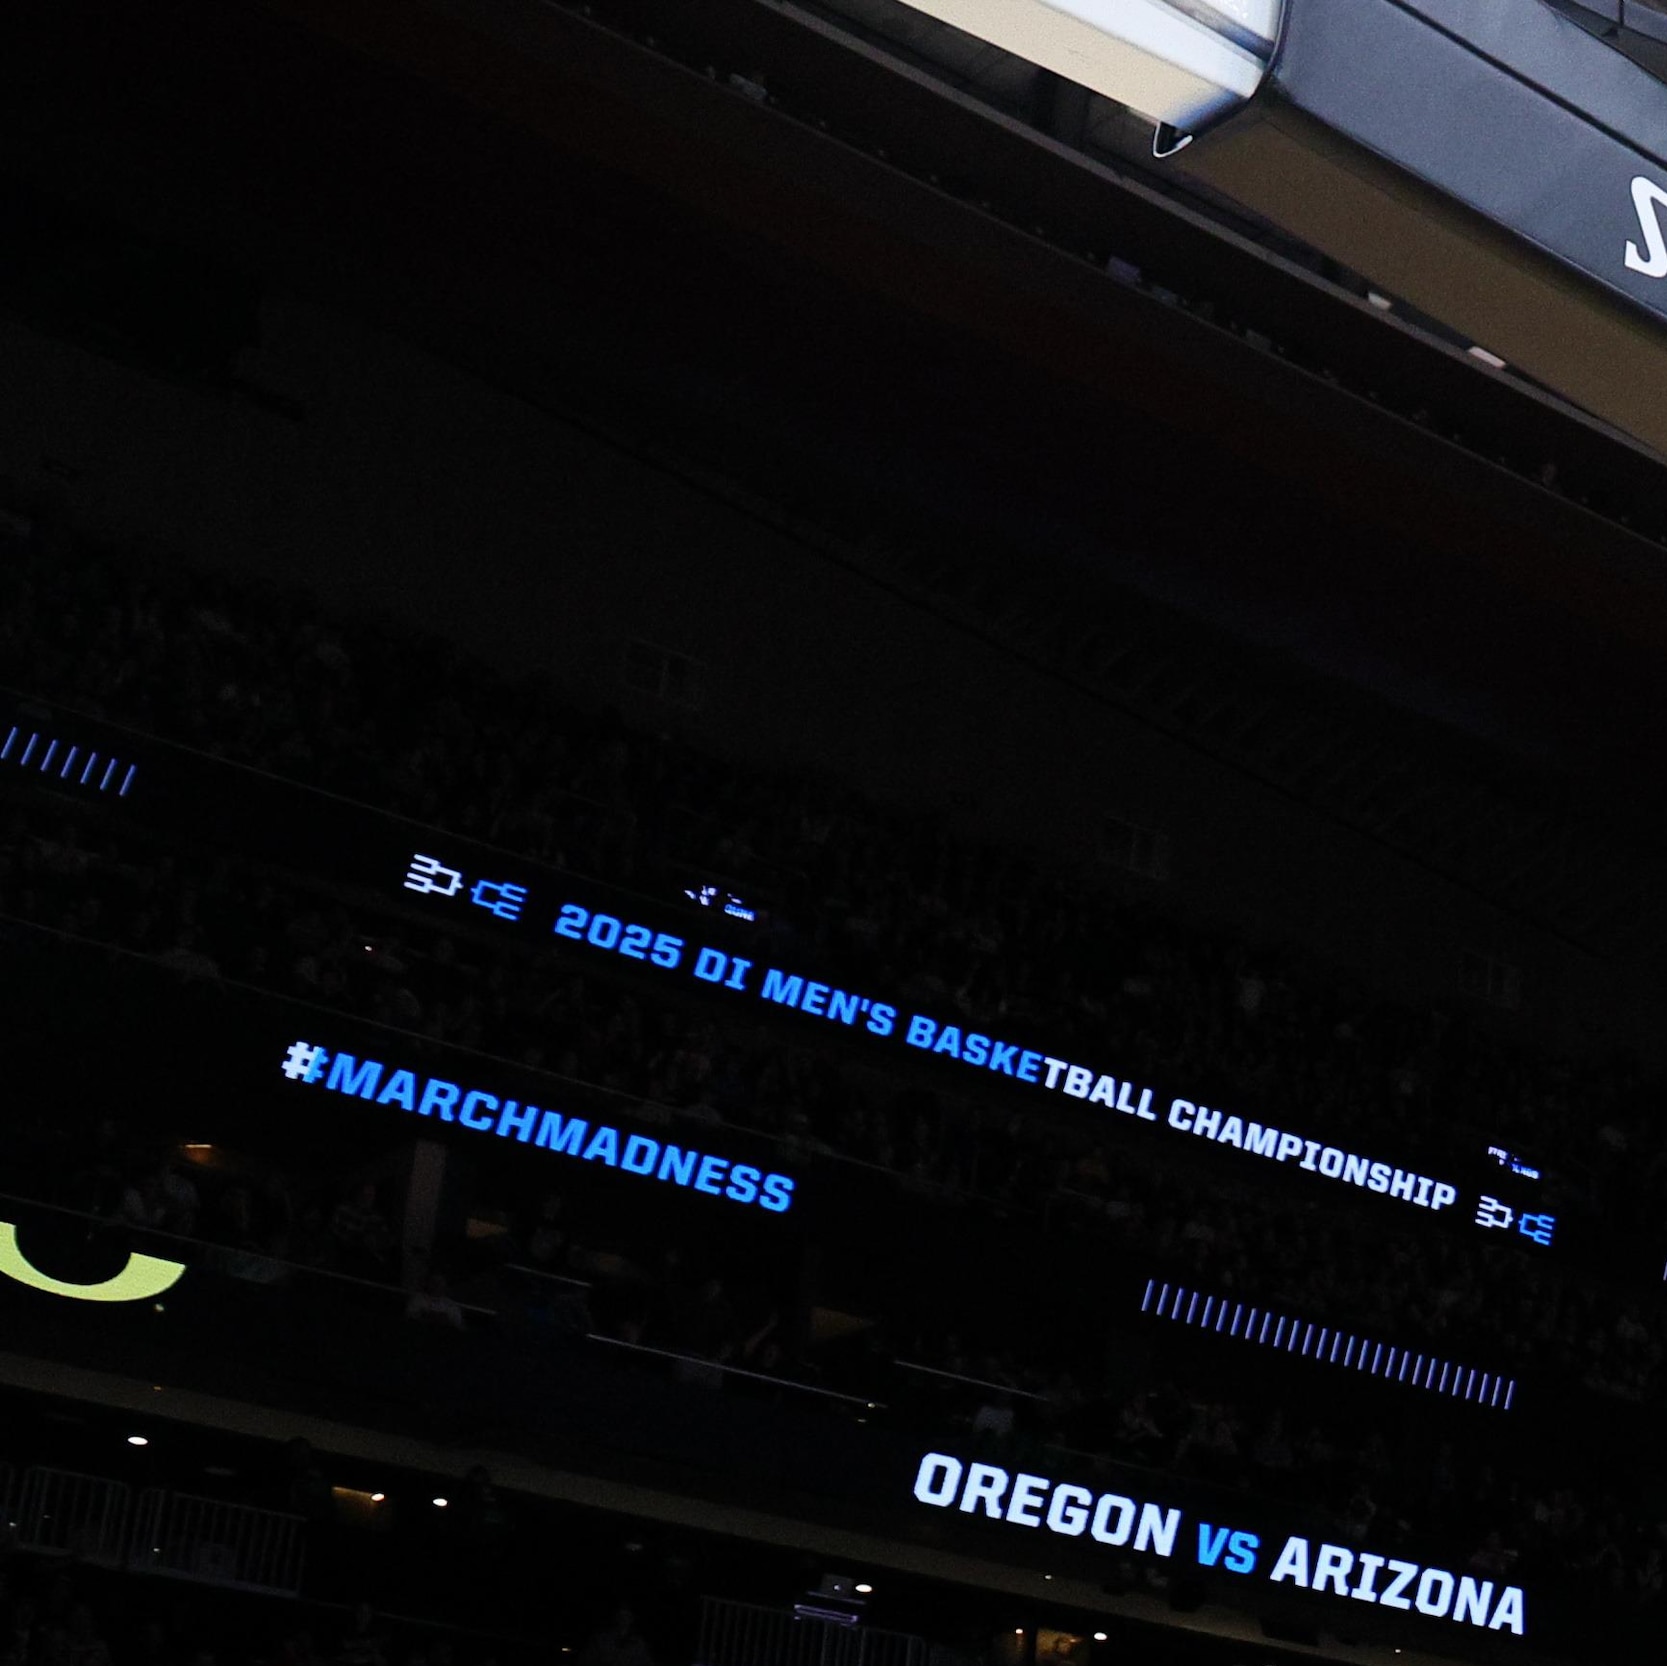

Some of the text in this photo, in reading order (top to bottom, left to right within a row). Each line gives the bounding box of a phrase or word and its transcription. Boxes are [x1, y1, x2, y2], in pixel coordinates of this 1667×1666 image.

[281, 1041, 795, 1214] #MARCHMADNESS
[555, 904, 684, 970] 2025
[692, 946, 752, 992] DI
[762, 968, 900, 1037] MEN'S
[906, 1015, 1157, 1122] BASKETBALL
[1168, 1098, 1457, 1211] CHAMPIONSHIP
[913, 1452, 1526, 1636] OREGON VS ARIZONA
